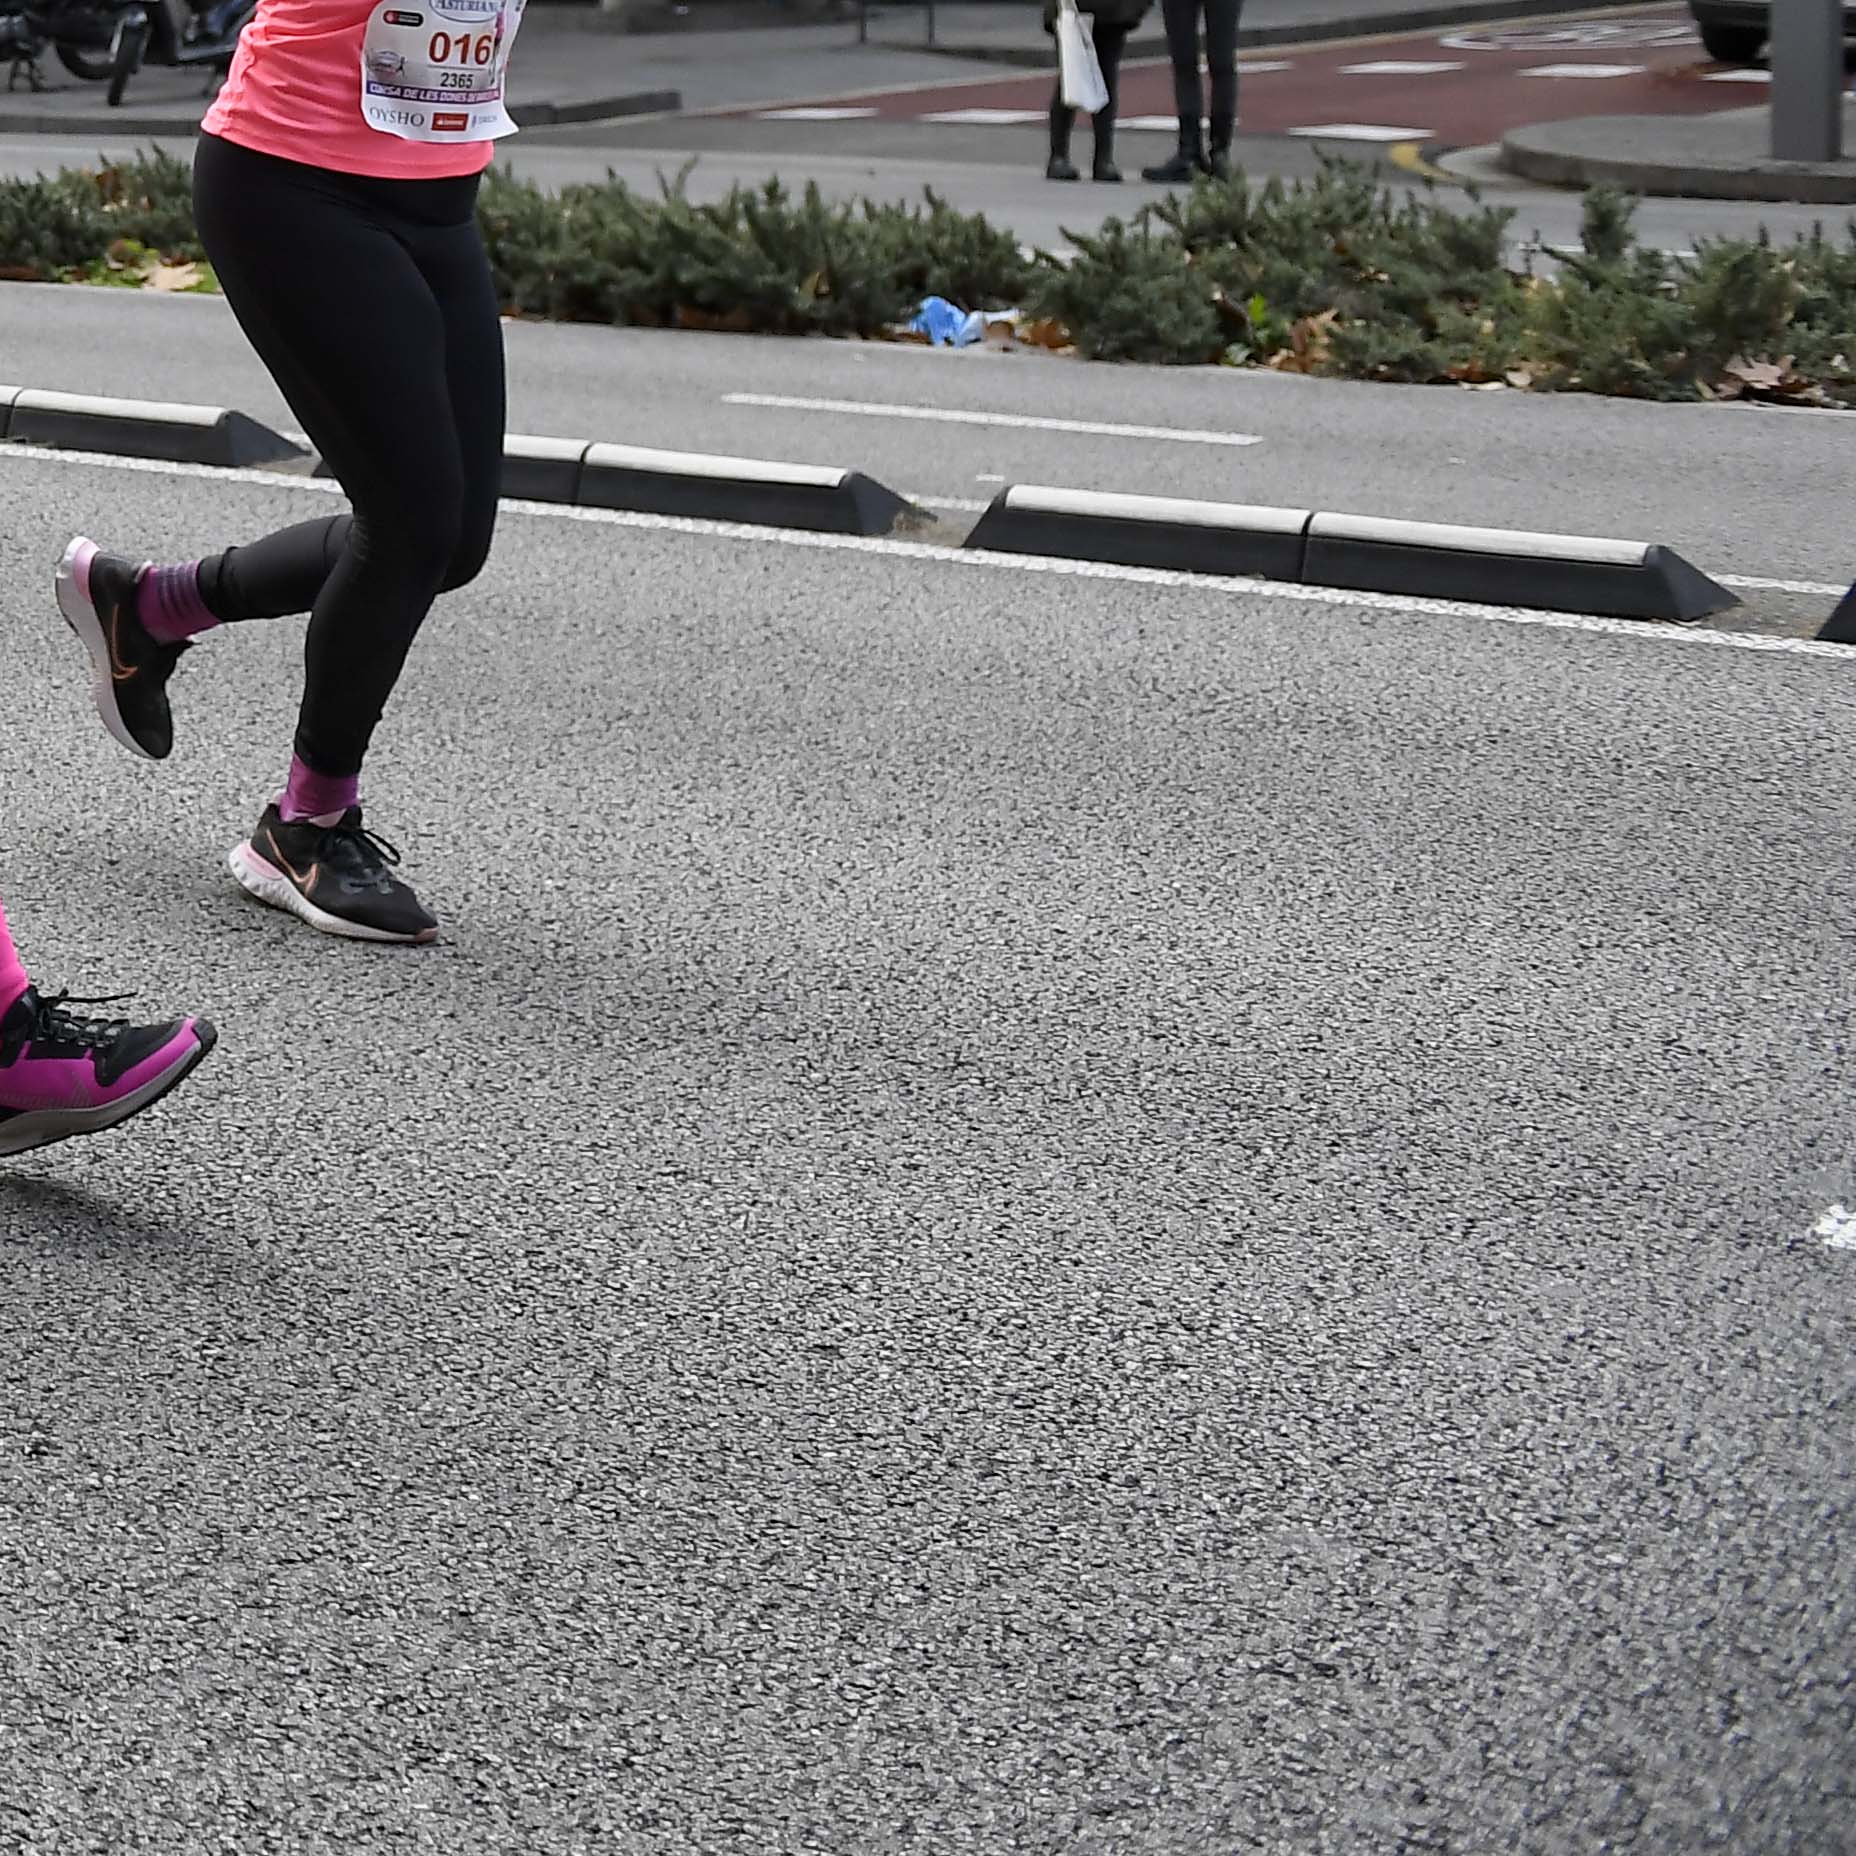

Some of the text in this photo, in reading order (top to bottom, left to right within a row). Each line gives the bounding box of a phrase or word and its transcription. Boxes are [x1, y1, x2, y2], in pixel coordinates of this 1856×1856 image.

[428, 31, 493, 65] 016
[439, 72, 474, 89] 2365
[403, 87, 418, 98] DE
[418, 88, 439, 101] LES
[369, 105, 425, 128] OYSHO
